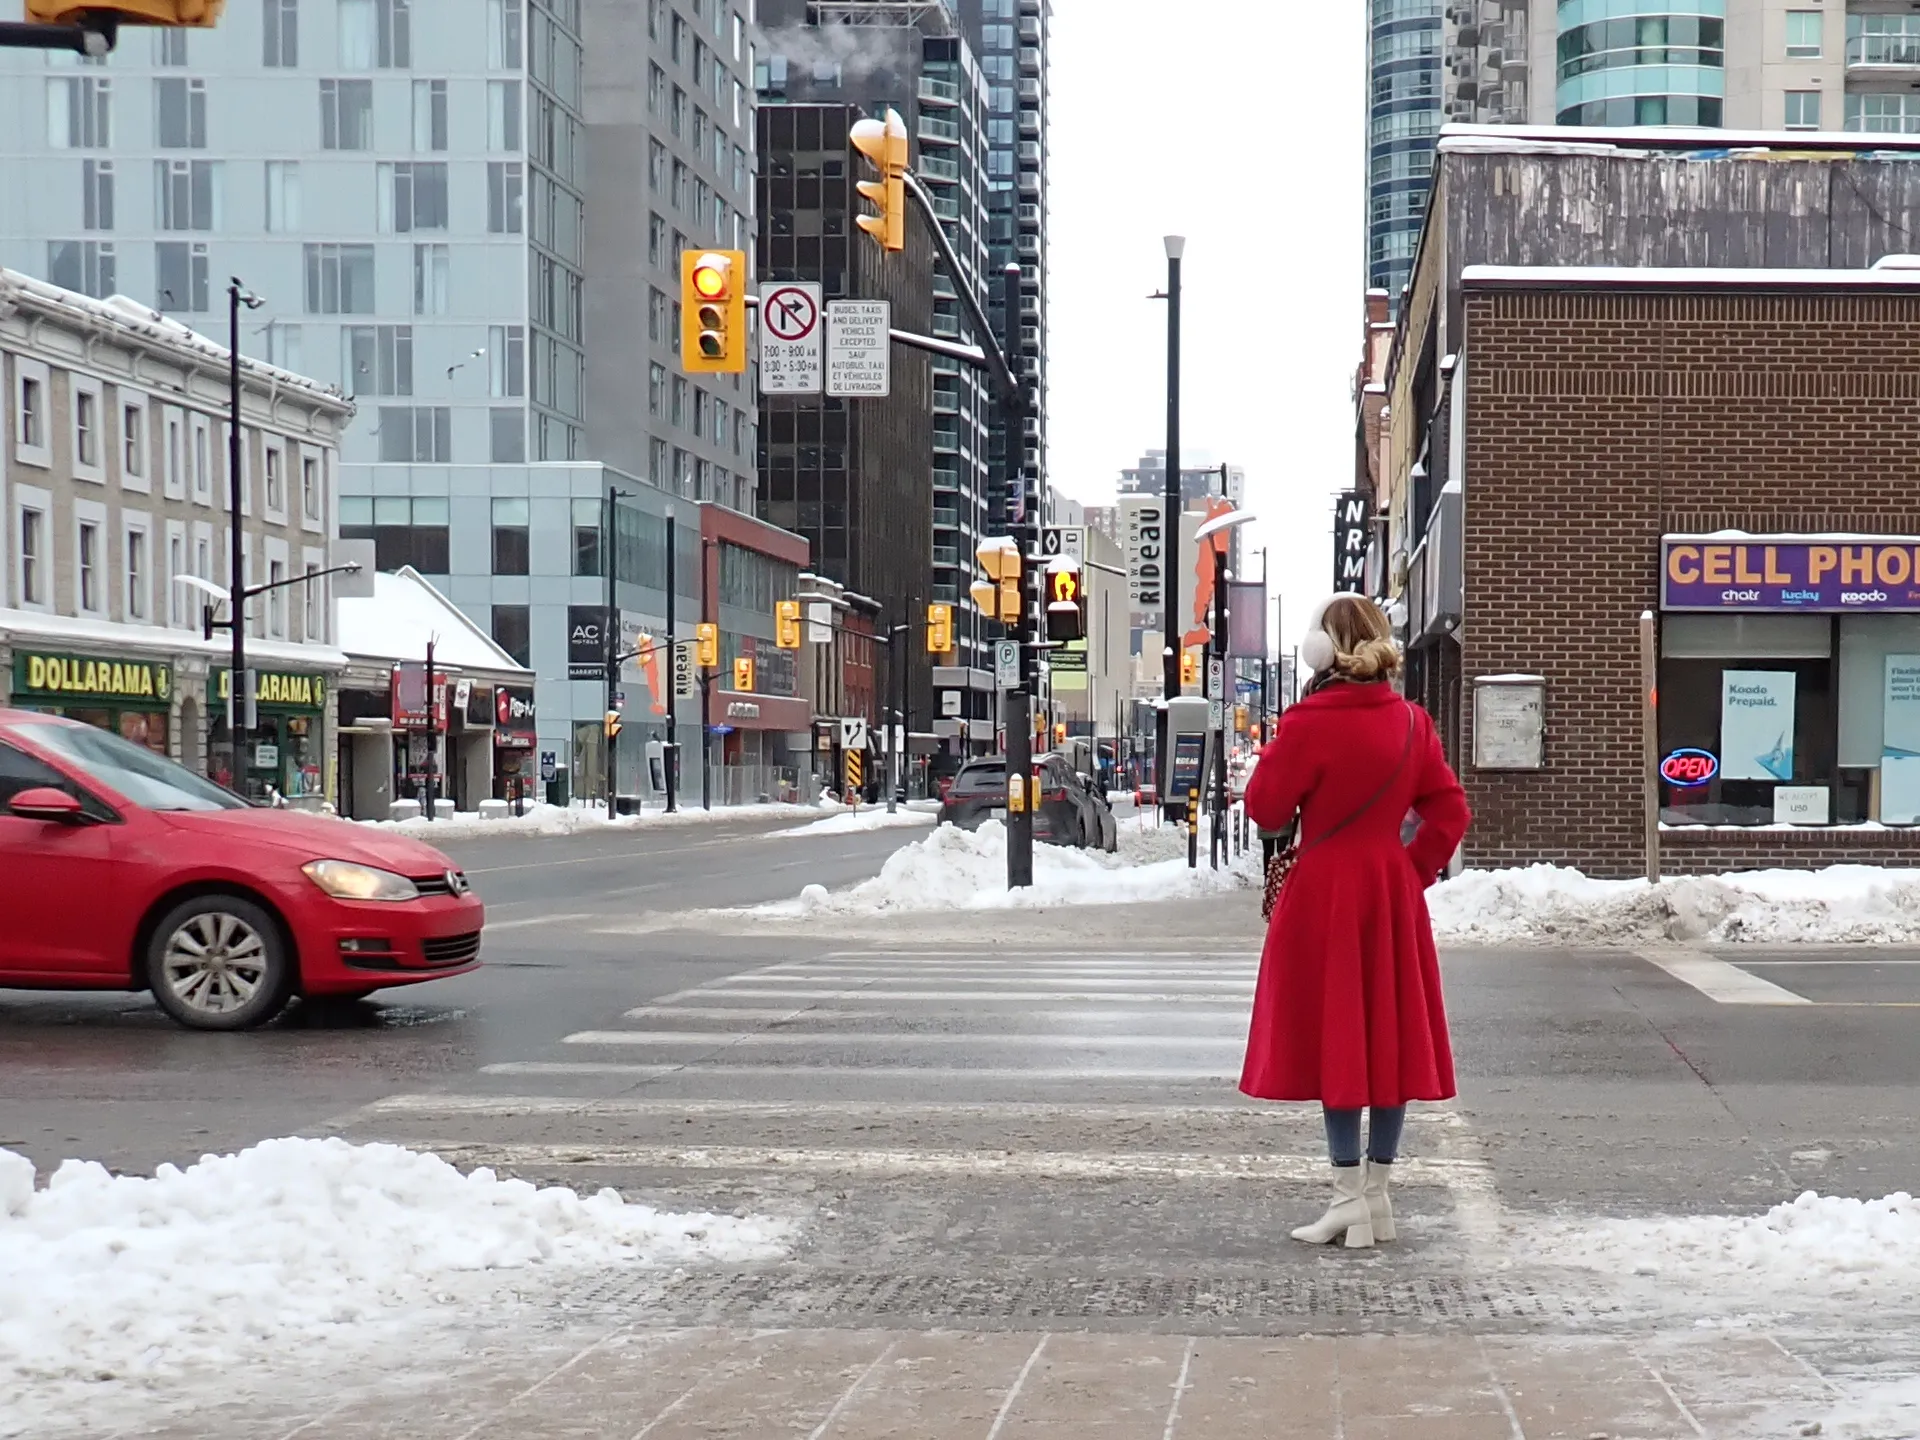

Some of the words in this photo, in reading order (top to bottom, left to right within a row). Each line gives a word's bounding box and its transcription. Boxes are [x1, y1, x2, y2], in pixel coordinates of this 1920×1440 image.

[862, 305, 882, 314] TAXIS
[833, 316, 848, 325] AND
[849, 316, 883, 325] DELIVERY
[841, 327, 875, 335] VEHICLES
[840, 338, 876, 346] EXCEPTED
[764, 345, 780, 357] 7:00
[788, 345, 805, 357] 9:00
[848, 350, 867, 359] SAUF
[764, 359, 781, 372] 3:30
[788, 359, 807, 372] 5:30
[868, 361, 885, 370] TAXI
[833, 371, 841, 380] ET
[833, 382, 843, 391] DE
[844, 382, 882, 391] LIVRAISON
[1130, 511, 1139, 599] DOWNTOWN
[1668, 545, 1791, 585] CELL
[1808, 545, 1920, 585] PHO
[1721, 589, 1760, 601] chatr
[1781, 589, 1819, 601] lucky
[1841, 589, 1888, 604] koodo
[572, 625, 599, 639] AC
[28, 656, 153, 695] DOLLARAMA
[1729, 684, 1767, 694] Koodo
[1729, 696, 1777, 708] Prepaid.
[1662, 757, 1713, 779] OPEN
[1790, 804, 1808, 812] USD
